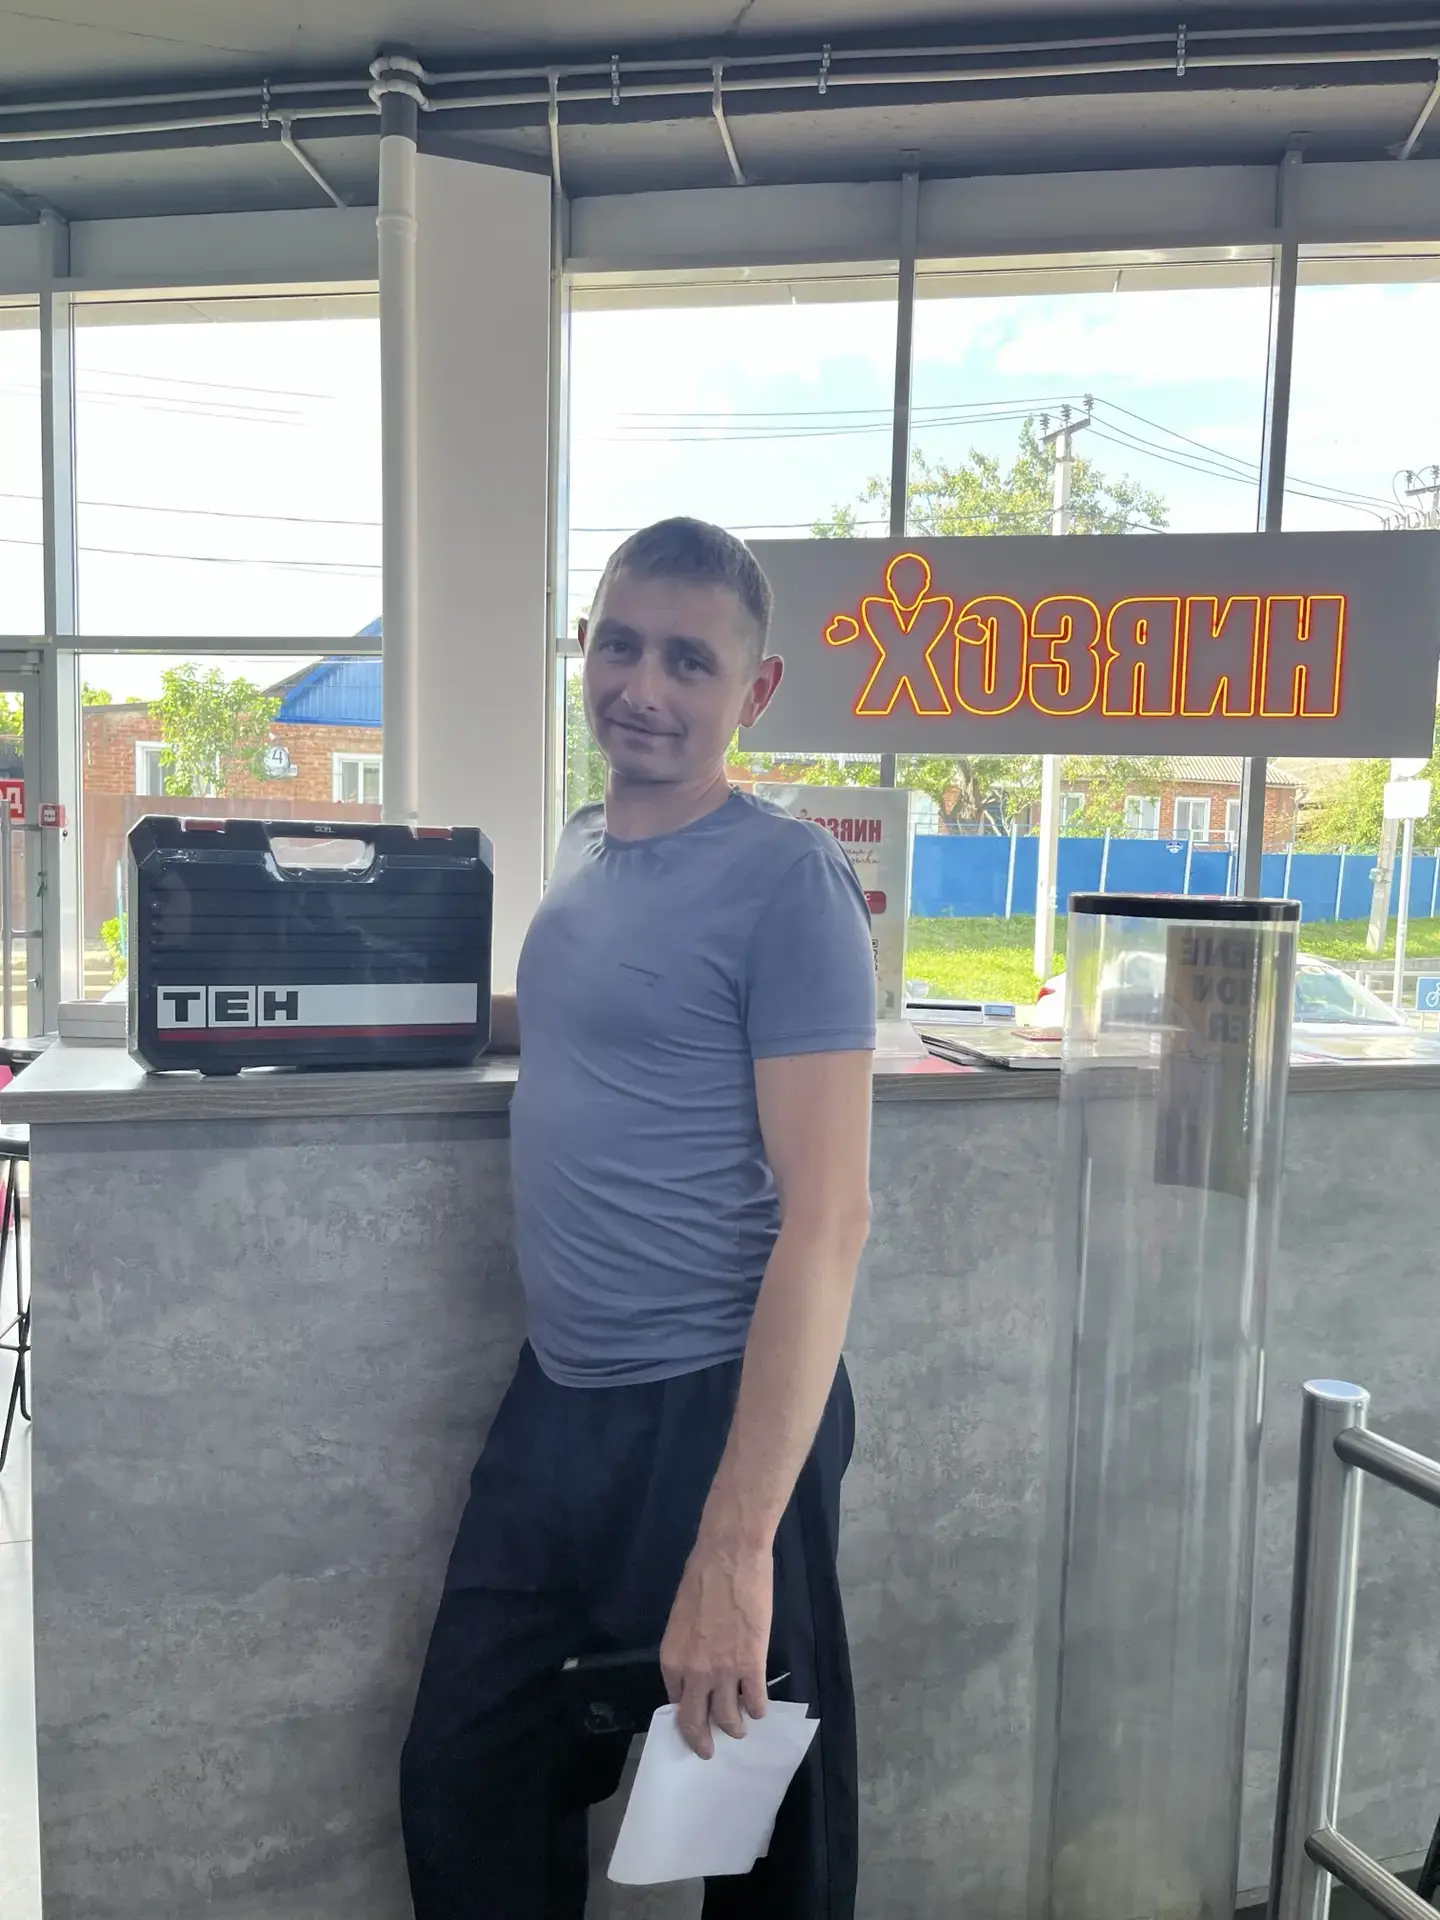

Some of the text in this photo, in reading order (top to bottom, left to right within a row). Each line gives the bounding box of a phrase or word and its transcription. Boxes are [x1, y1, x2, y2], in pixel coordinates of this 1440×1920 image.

[854, 594, 1346, 718] ХОЗЯИН
[0, 786, 23, 814] Д
[795, 816, 882, 843] ЗЯИН
